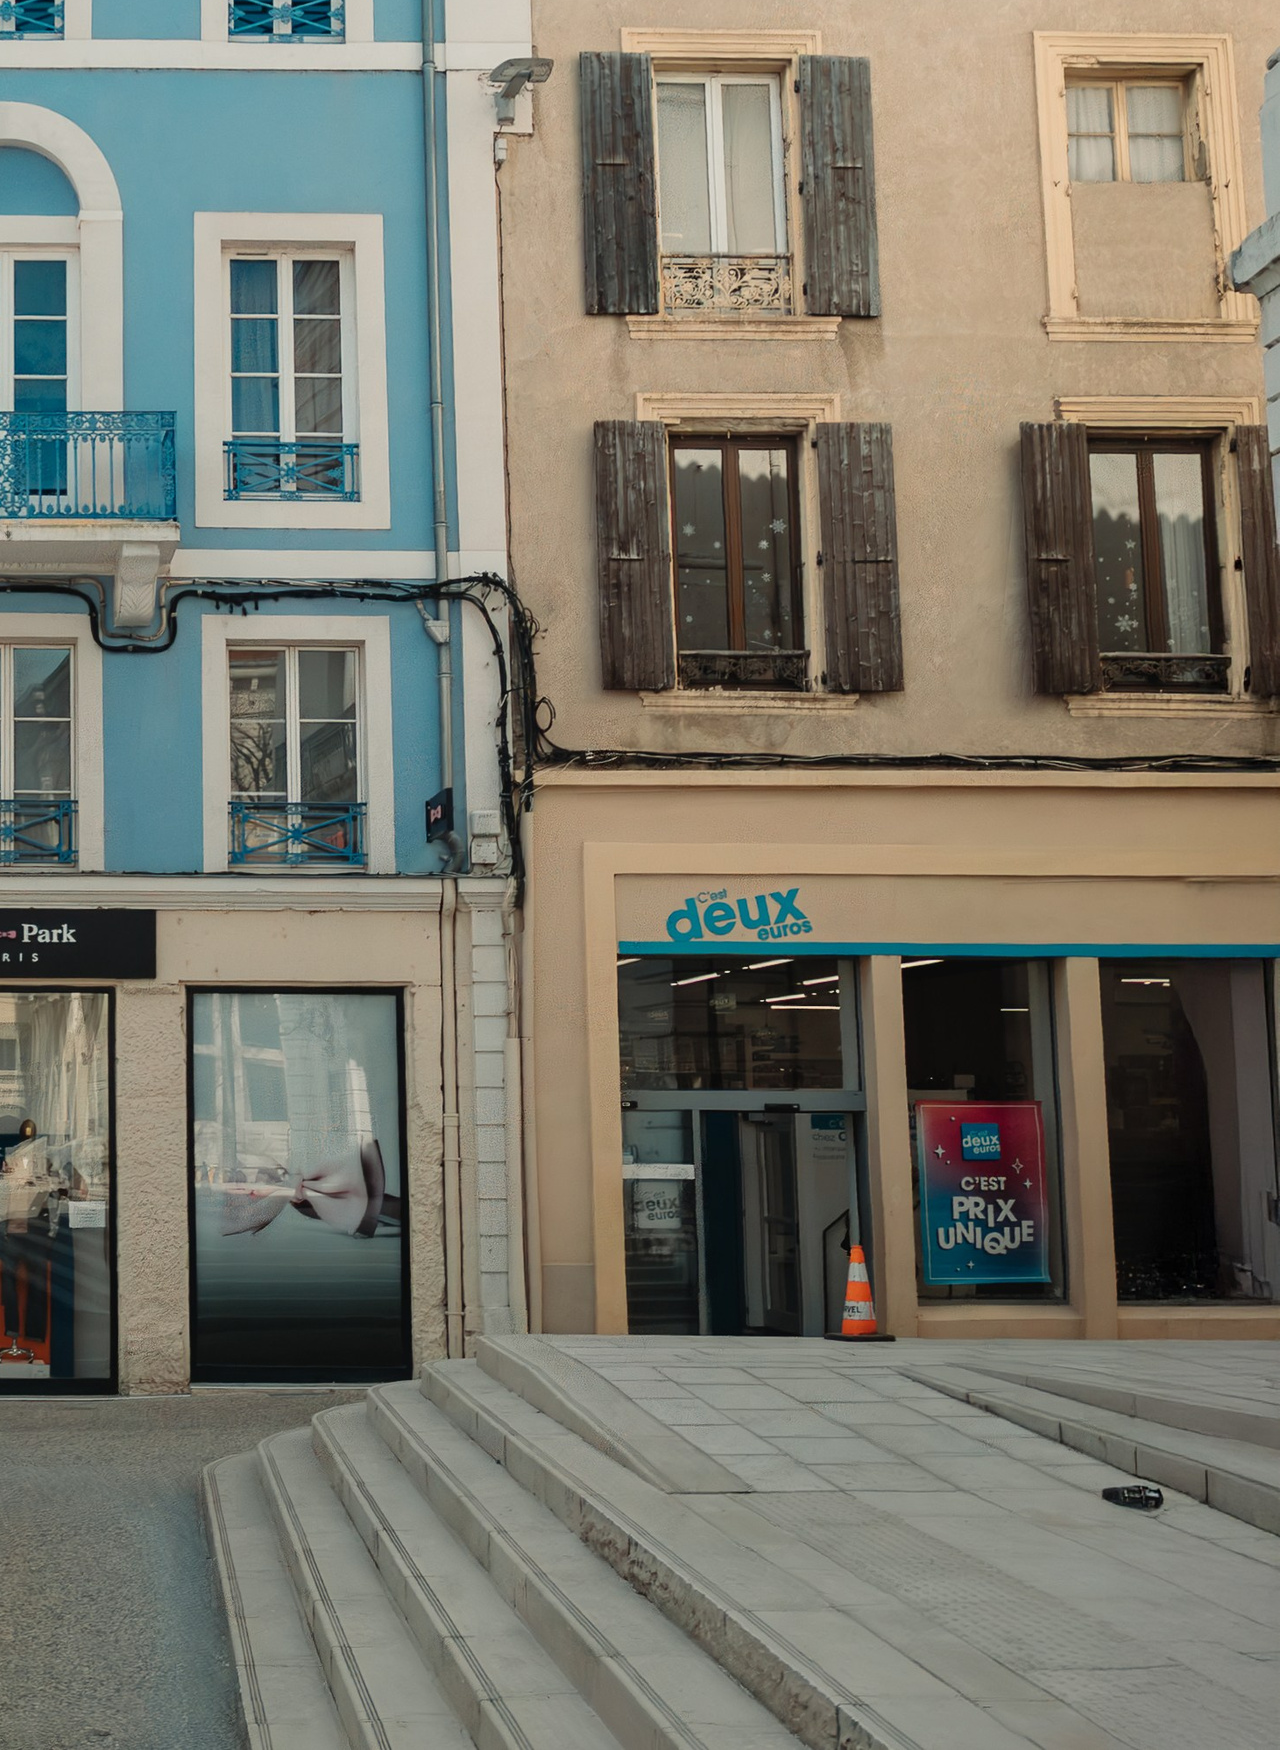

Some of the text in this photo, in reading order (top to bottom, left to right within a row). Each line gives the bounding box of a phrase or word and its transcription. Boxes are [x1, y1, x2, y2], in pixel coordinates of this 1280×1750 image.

[697, 888, 728, 903] C'est
[666, 888, 808, 942] deux
[21, 923, 77, 943] Park
[757, 920, 813, 941] euros
[962, 1135, 1000, 1148] deux
[961, 1176, 1007, 1191] C'EST
[952, 1196, 1017, 1227] PRIX
[938, 1220, 1034, 1254] UNIQUE
